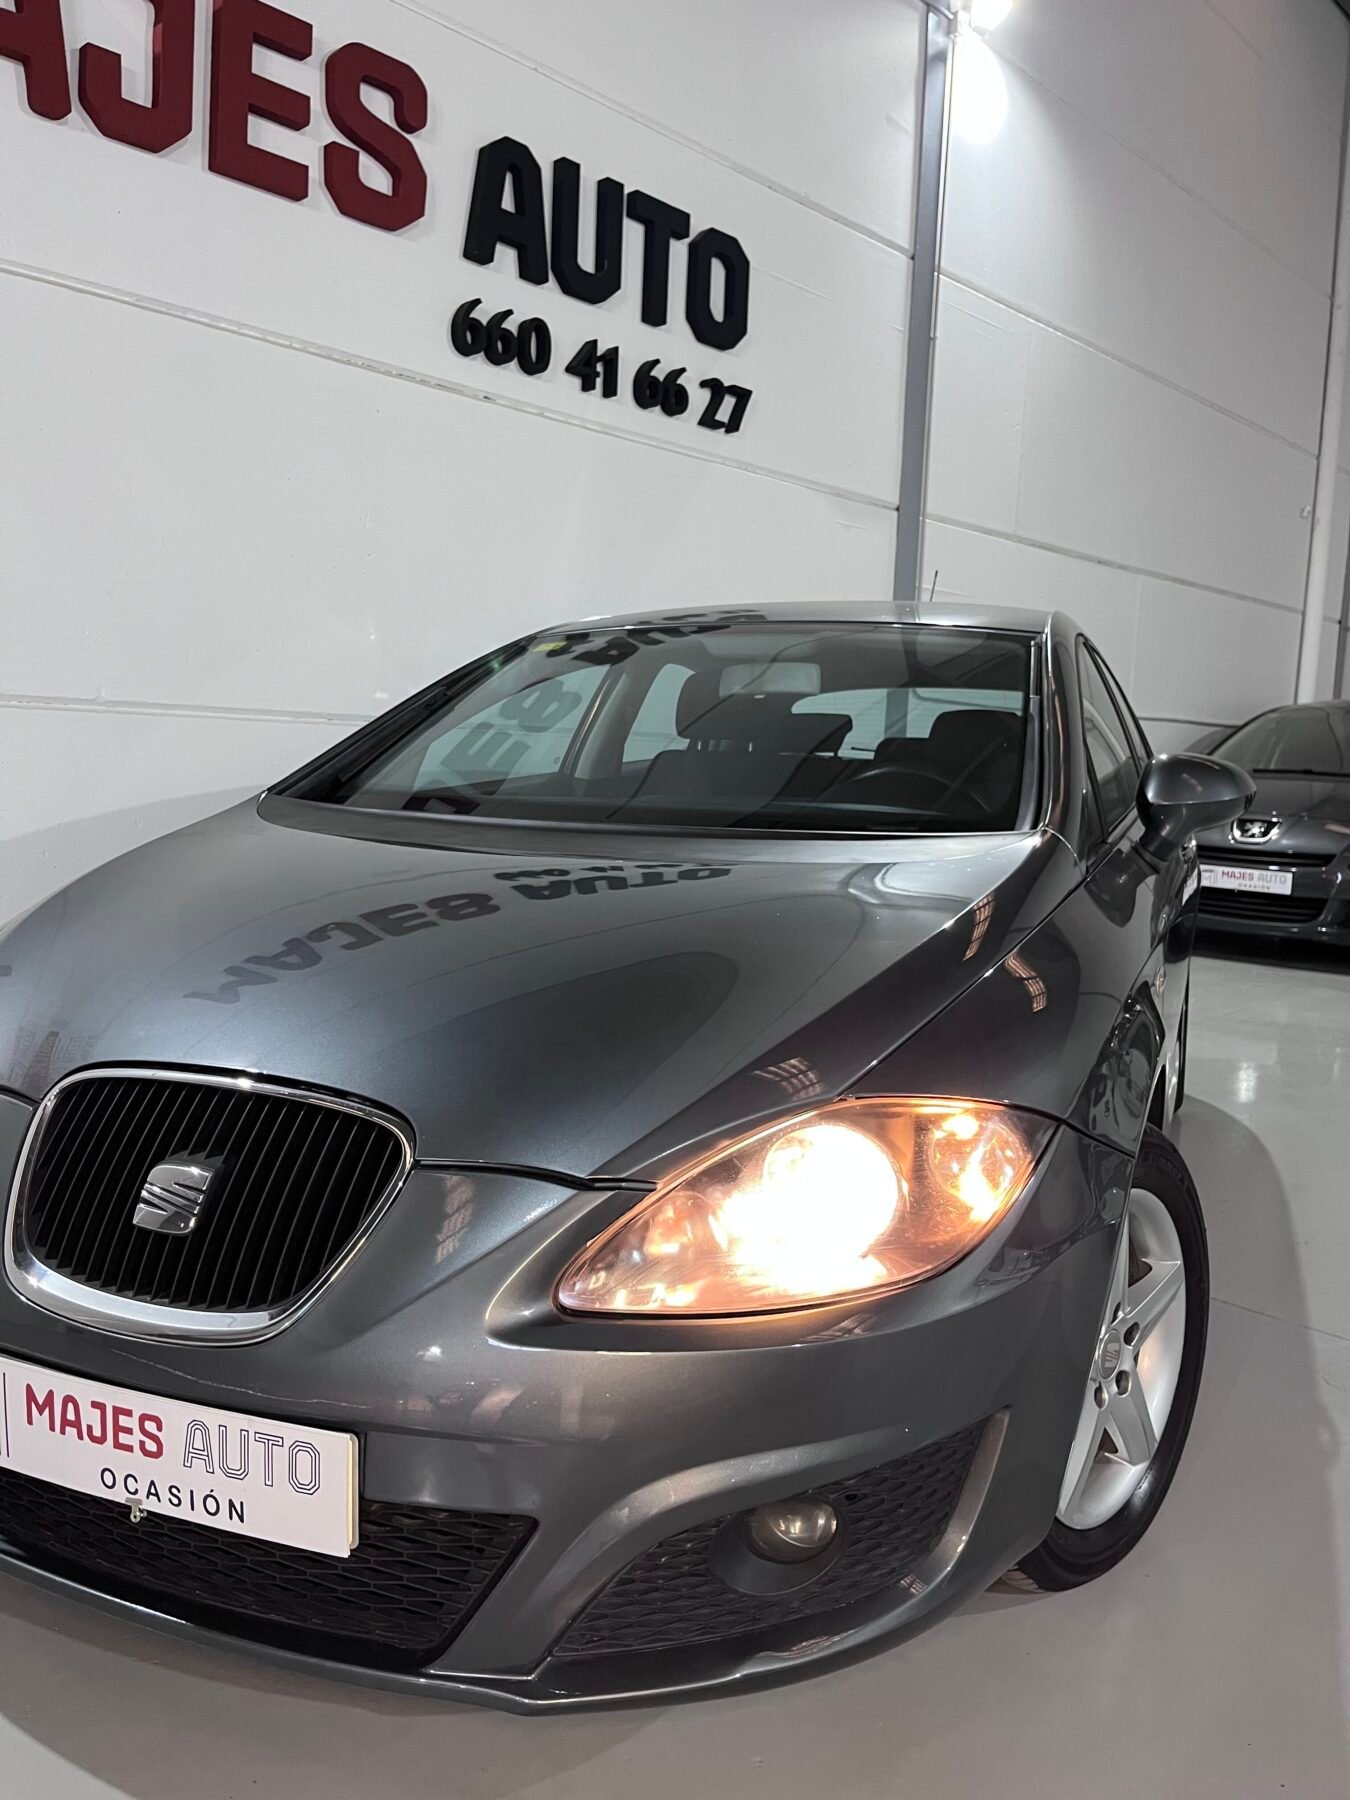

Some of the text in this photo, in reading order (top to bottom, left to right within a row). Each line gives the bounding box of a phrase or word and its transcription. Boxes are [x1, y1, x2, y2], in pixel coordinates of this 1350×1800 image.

[462, 136, 750, 351] AUTO
[451, 298, 753, 434] 660 41 66 27
[1221, 869, 1287, 885] MAJES AUTO
[25, 1383, 321, 1496] MAJES AUTO
[100, 1467, 245, 1524] OCASIÓN
